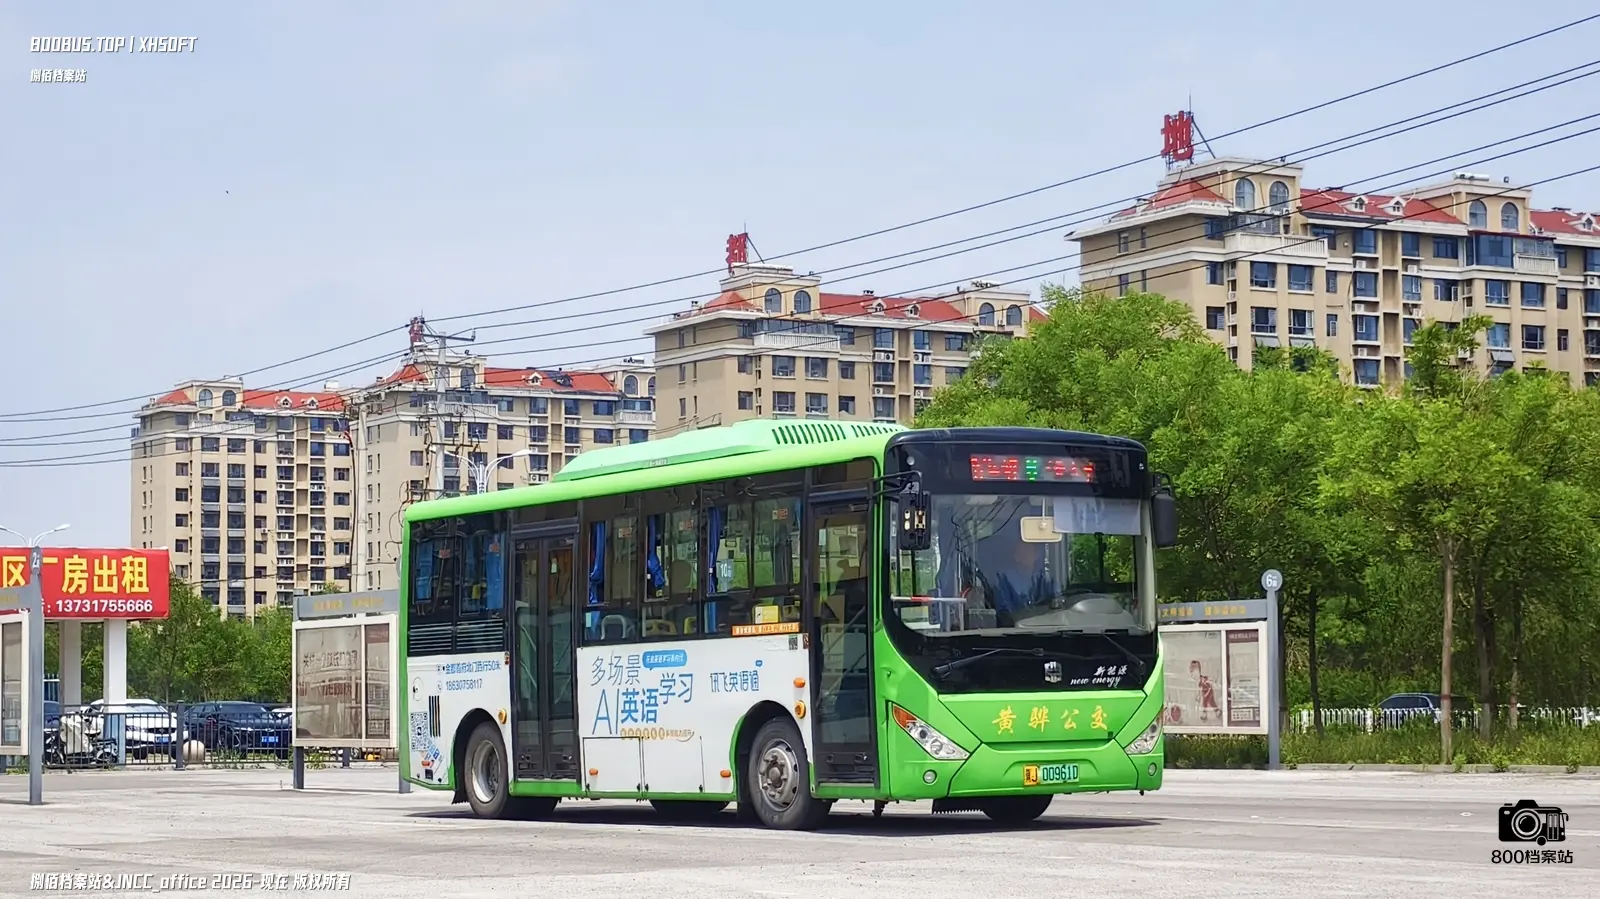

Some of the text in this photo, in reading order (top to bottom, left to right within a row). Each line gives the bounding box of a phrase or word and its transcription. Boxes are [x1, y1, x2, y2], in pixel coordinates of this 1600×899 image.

[1161, 111, 1193, 161] 地
[56, 600, 153, 612] 13731755666
[590, 650, 641, 686] 多场景
[1094, 665, 1128, 676] 新能源
[710, 670, 760, 692] 讯飞英语通
[1092, 676, 1121, 688] energy
[992, 705, 1107, 735] 黄骅公交
[1042, 765, 1079, 781] 00961D
